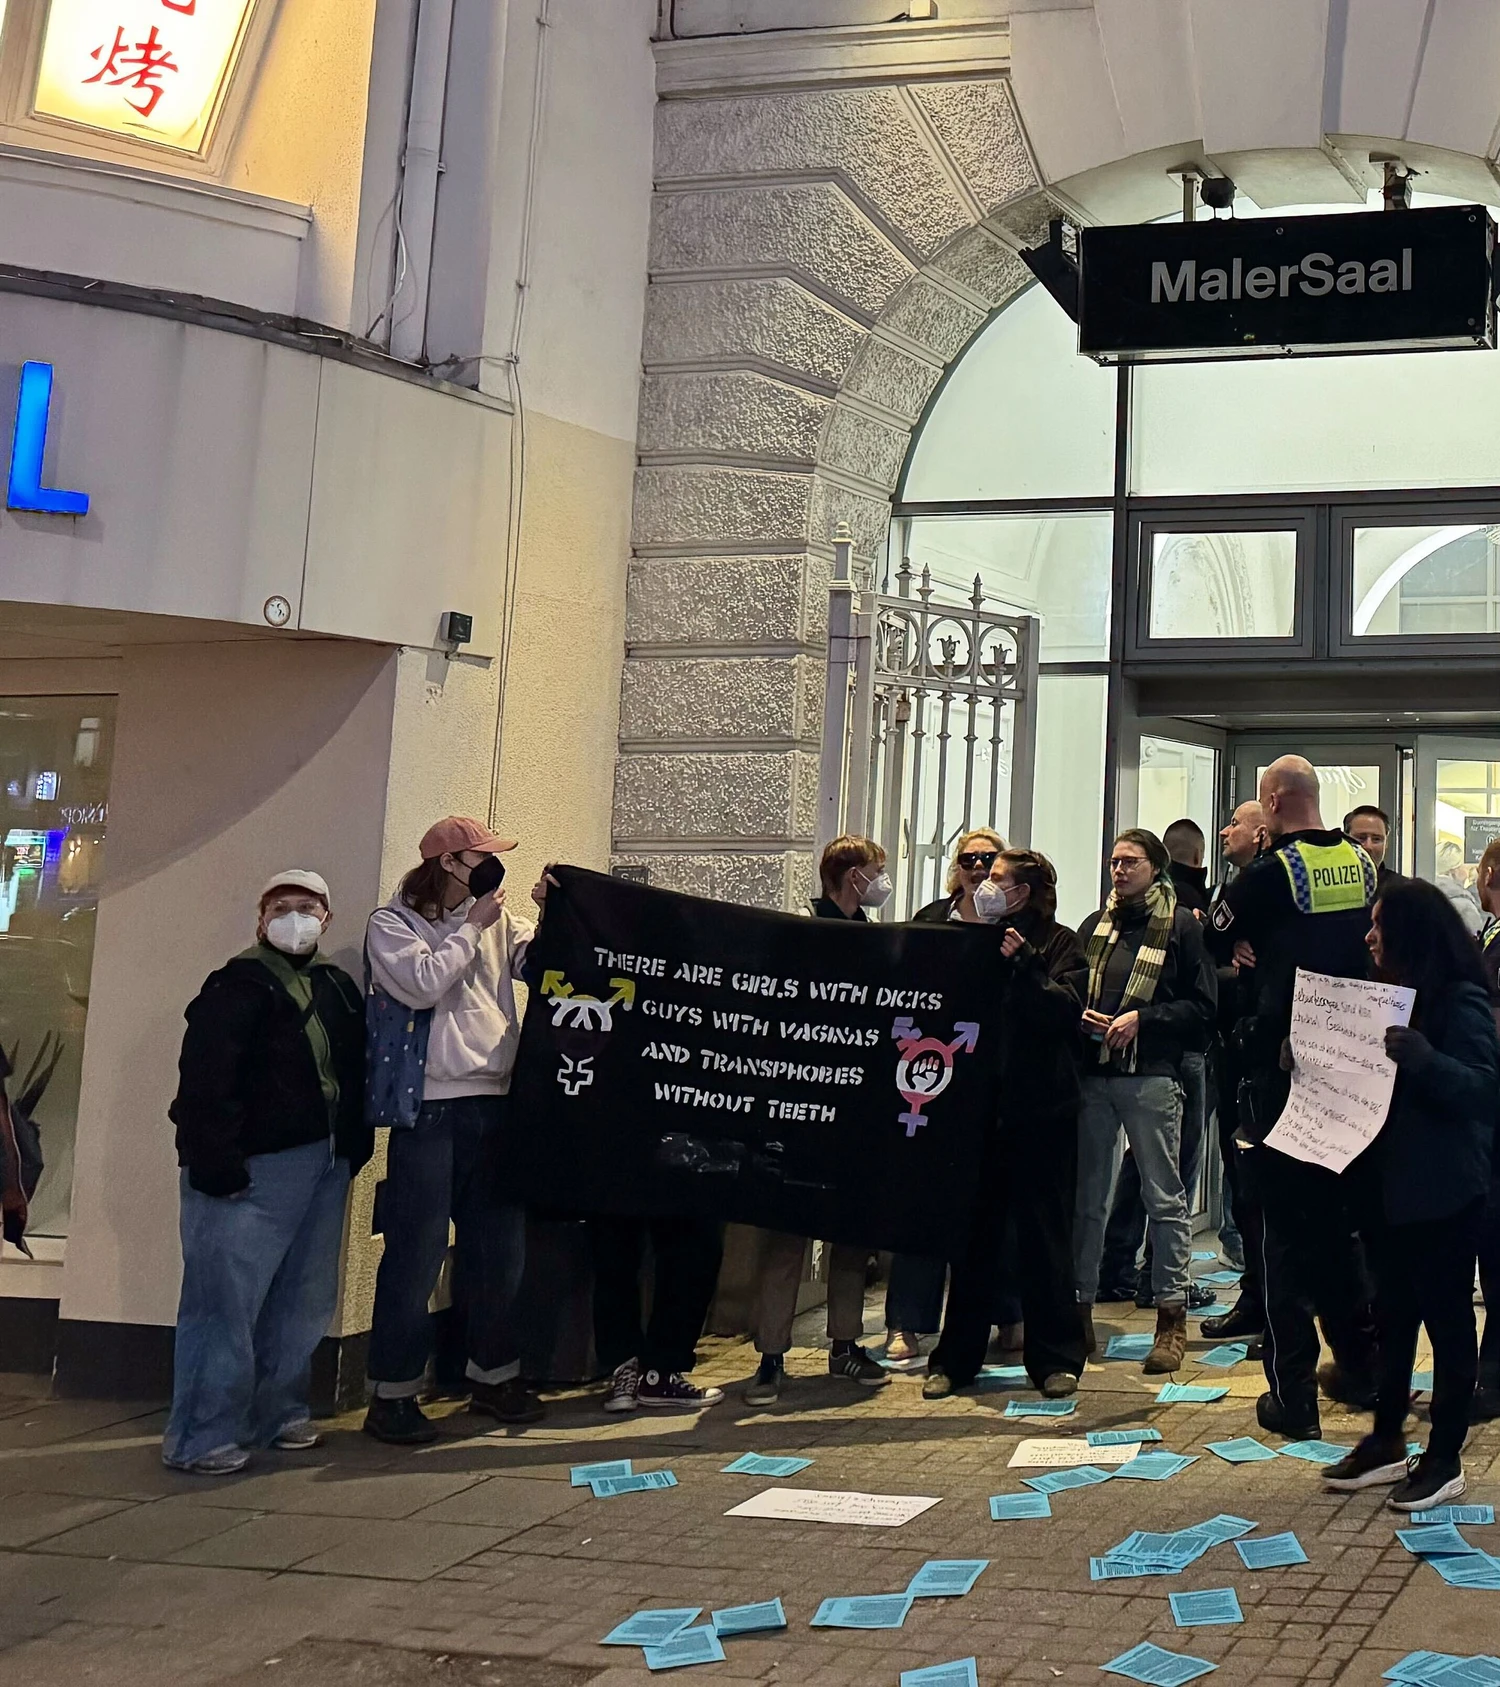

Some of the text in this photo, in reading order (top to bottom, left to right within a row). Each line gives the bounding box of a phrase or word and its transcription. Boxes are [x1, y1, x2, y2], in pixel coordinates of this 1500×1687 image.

[81, 0, 196, 118] 烤
[1150, 247, 1413, 304] MalerSaal
[7, 360, 89, 516] L
[1312, 862, 1363, 889] POLIZEI
[593, 946, 943, 1012] THERE ARE GIRLS WITH DICKS
[641, 999, 880, 1048] GUYS WITH VAGINAS
[641, 1042, 865, 1086] AND TRANSPHOBES
[654, 1082, 837, 1124] WITHOUT TEETH
